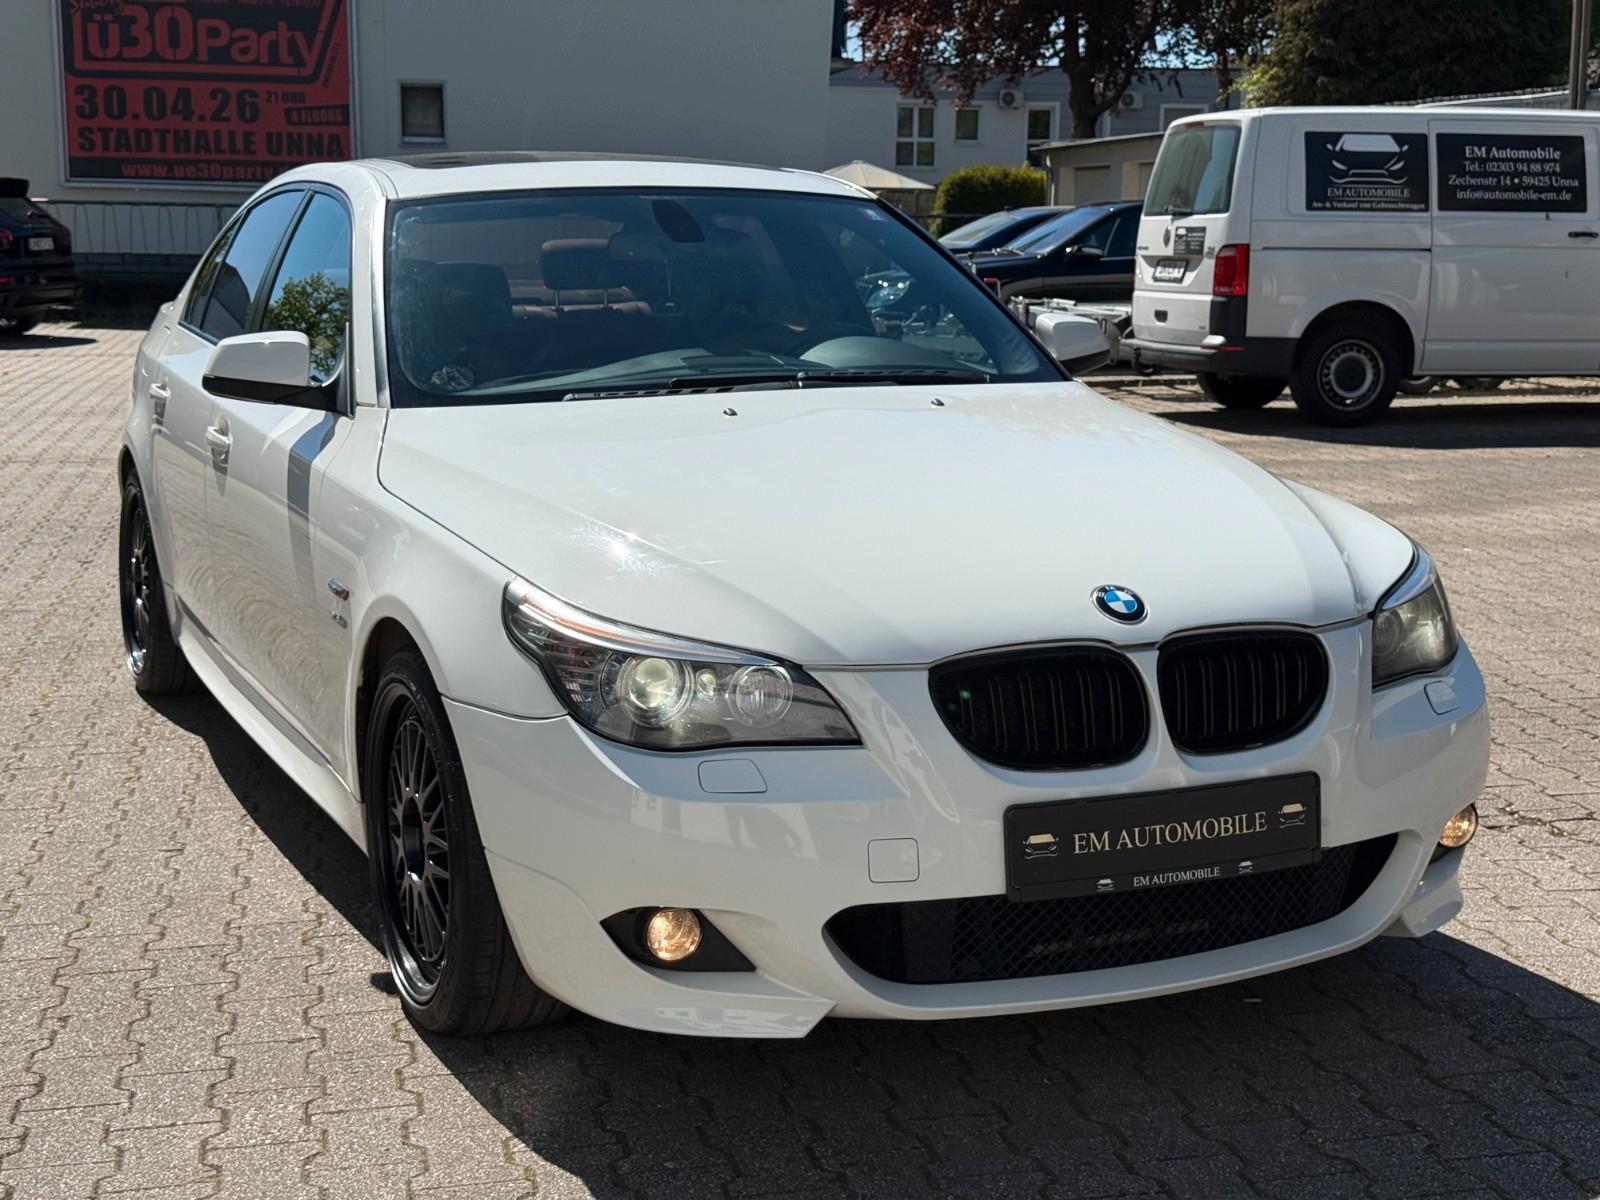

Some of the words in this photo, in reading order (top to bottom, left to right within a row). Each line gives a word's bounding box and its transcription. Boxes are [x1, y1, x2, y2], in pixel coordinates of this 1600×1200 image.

[75, 85, 260, 122] 30.04.26
[78, 127, 256, 155] STADTHALLE
[265, 131, 344, 157] UNNA
[1465, 146, 1486, 158] EM
[1489, 146, 1561, 159] Automobile
[1486, 161, 1514, 172] 02303
[1516, 162, 1528, 172] 94
[1530, 162, 1541, 172] 88
[1543, 162, 1560, 173] 974
[1448, 174, 1497, 185] Zechenstr
[1500, 175, 1511, 186] 14
[1521, 175, 1550, 187] 59425
[1552, 176, 1579, 187] Unna
[1327, 187, 1342, 197] EM
[1344, 187, 1410, 198] AUTOMOBILE
[1456, 188, 1572, 201] info@automobile-em.de
[1073, 832, 1111, 854] EM
[1115, 811, 1268, 850] AUTOMOBILE
[1133, 876, 1150, 887] EM
[1152, 866, 1221, 886] AUTOMOBILE
